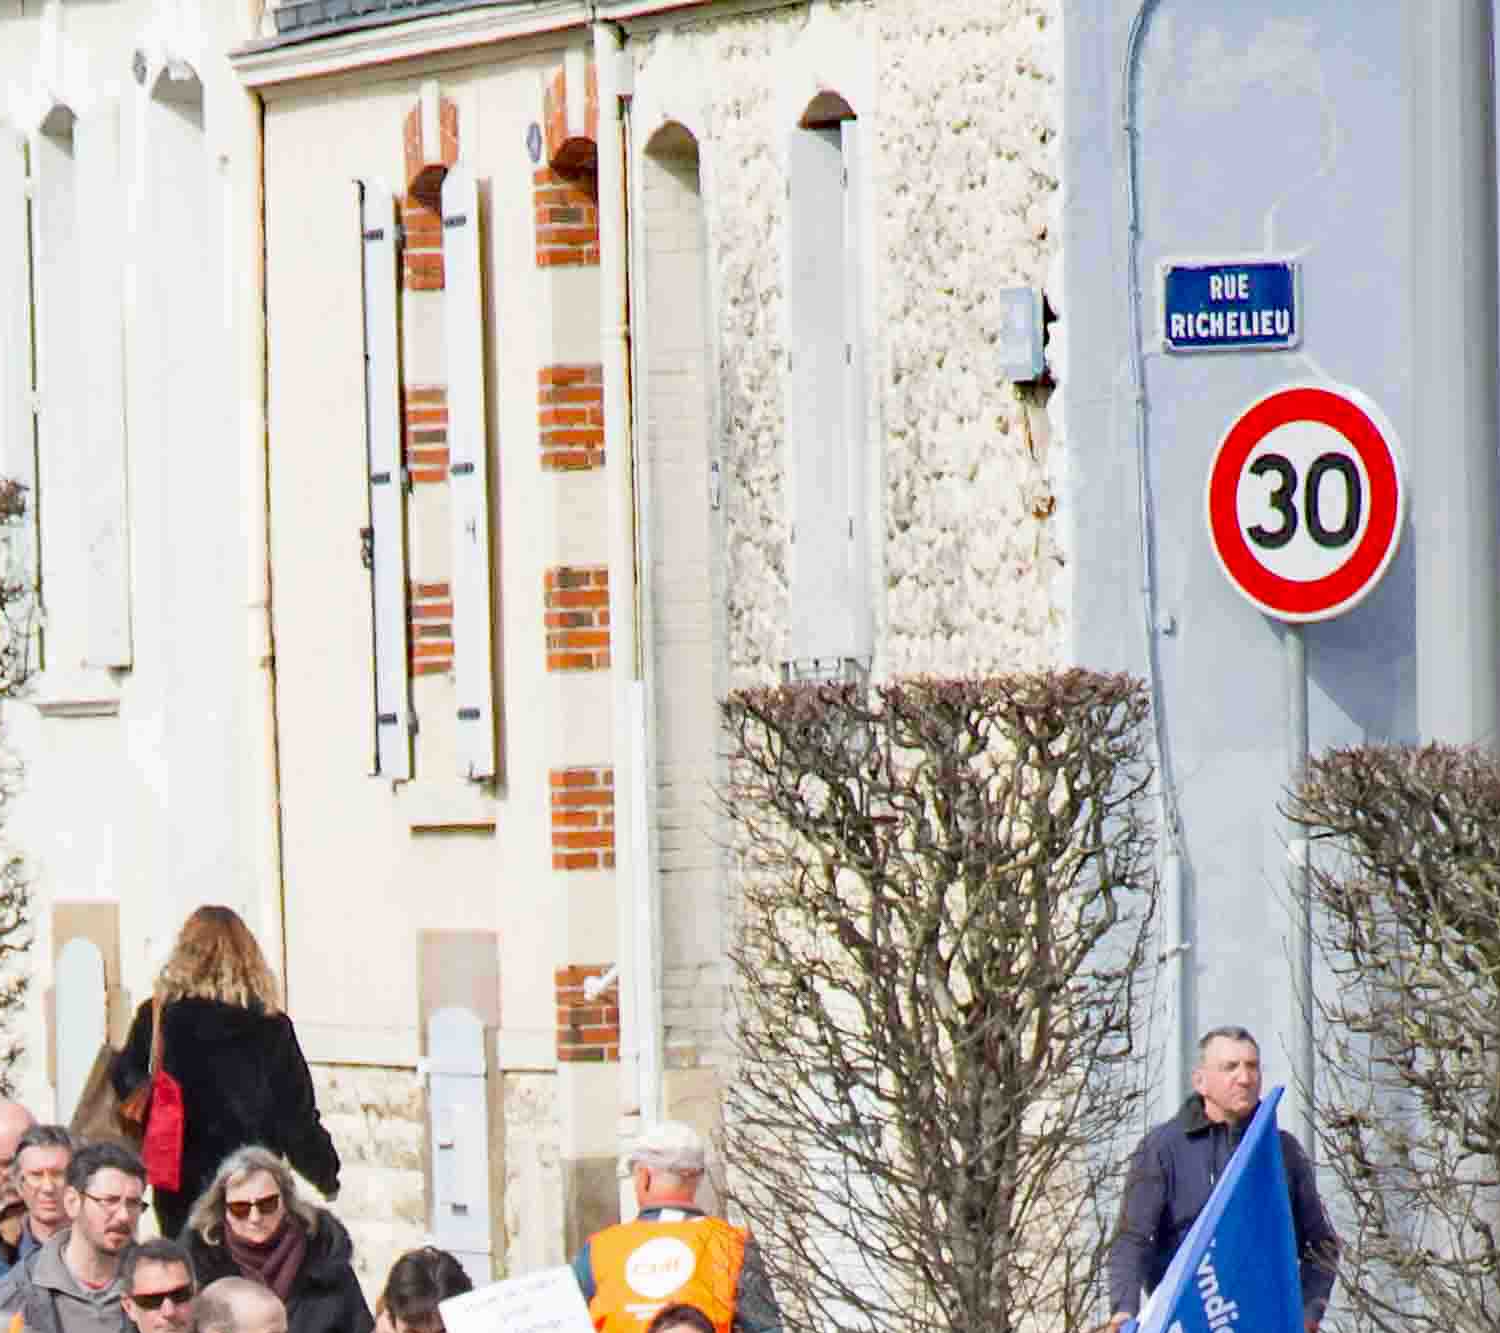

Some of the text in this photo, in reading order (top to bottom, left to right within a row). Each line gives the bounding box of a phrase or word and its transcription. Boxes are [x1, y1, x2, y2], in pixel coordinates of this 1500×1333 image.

[1209, 274, 1249, 300] RUE
[1171, 309, 1290, 338] RICHELIEU
[1247, 454, 1363, 549] 30
